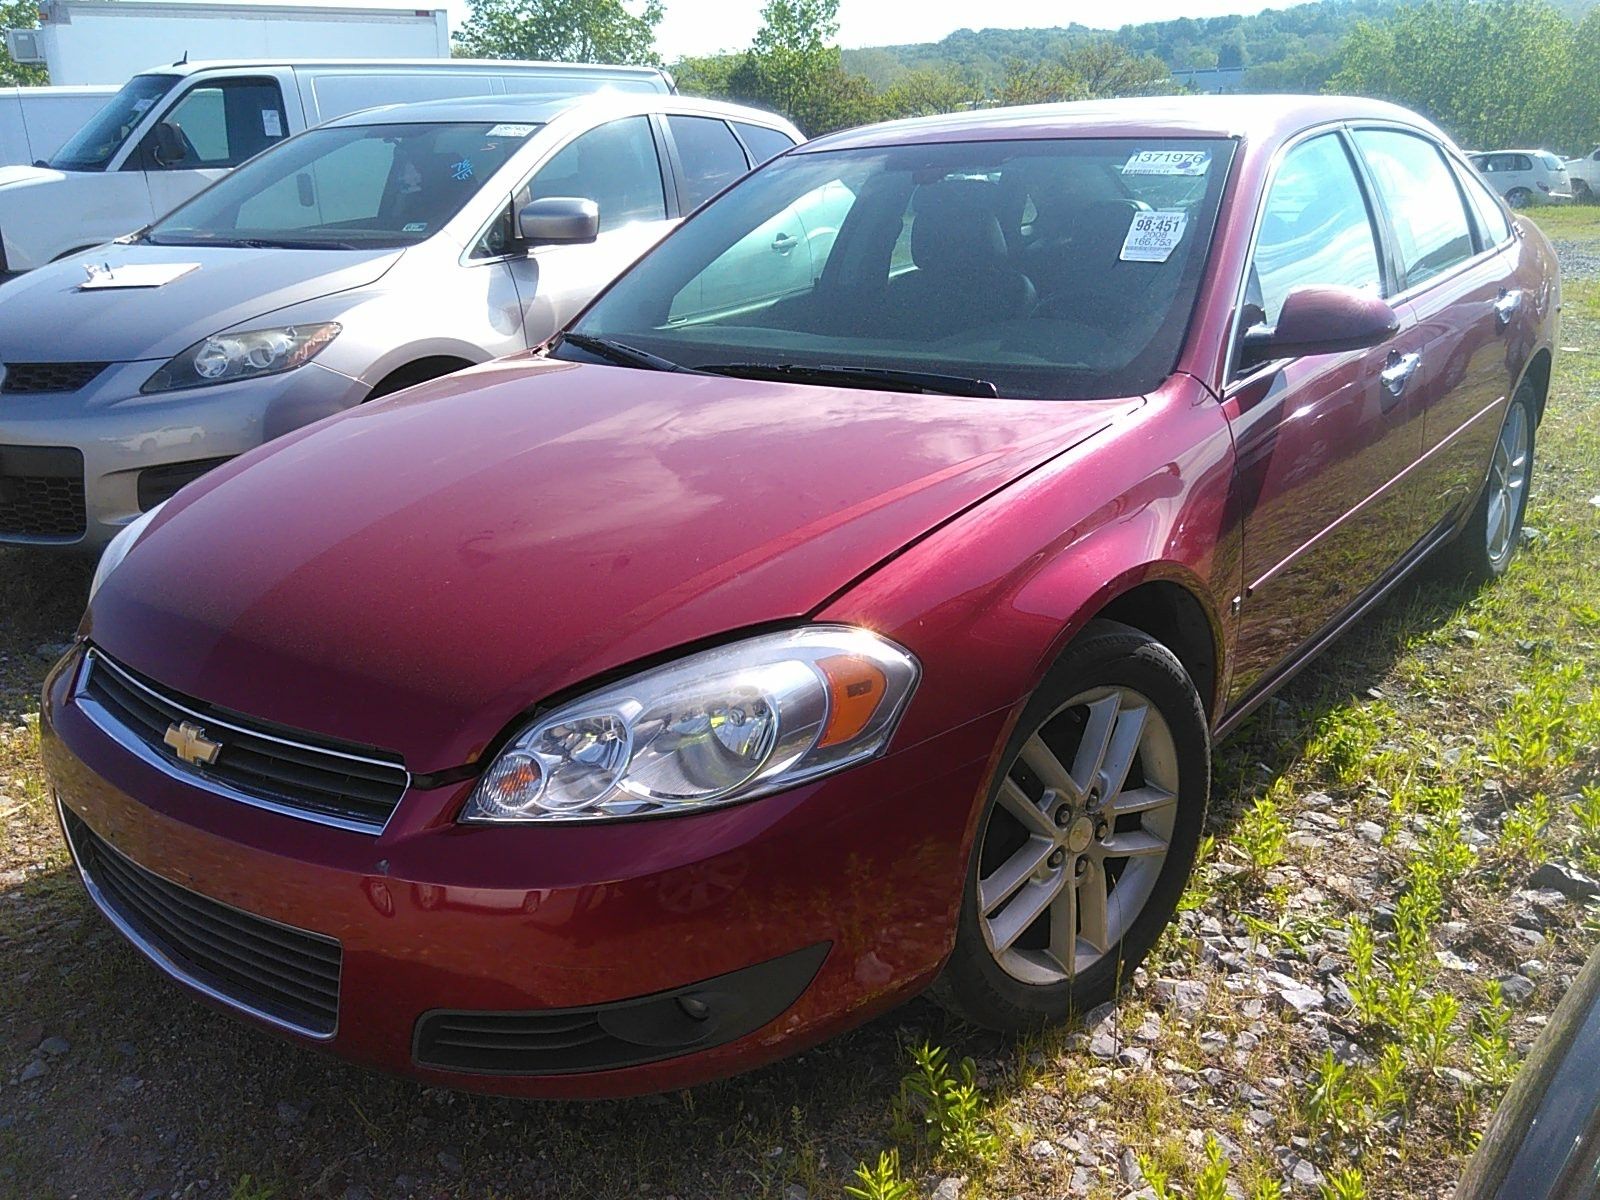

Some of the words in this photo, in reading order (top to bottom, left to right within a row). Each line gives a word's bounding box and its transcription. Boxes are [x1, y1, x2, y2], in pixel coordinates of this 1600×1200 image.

[1134, 153, 1204, 163] 1371976
[1136, 219, 1180, 232] 98:451
[1143, 231, 1168, 239] 2008
